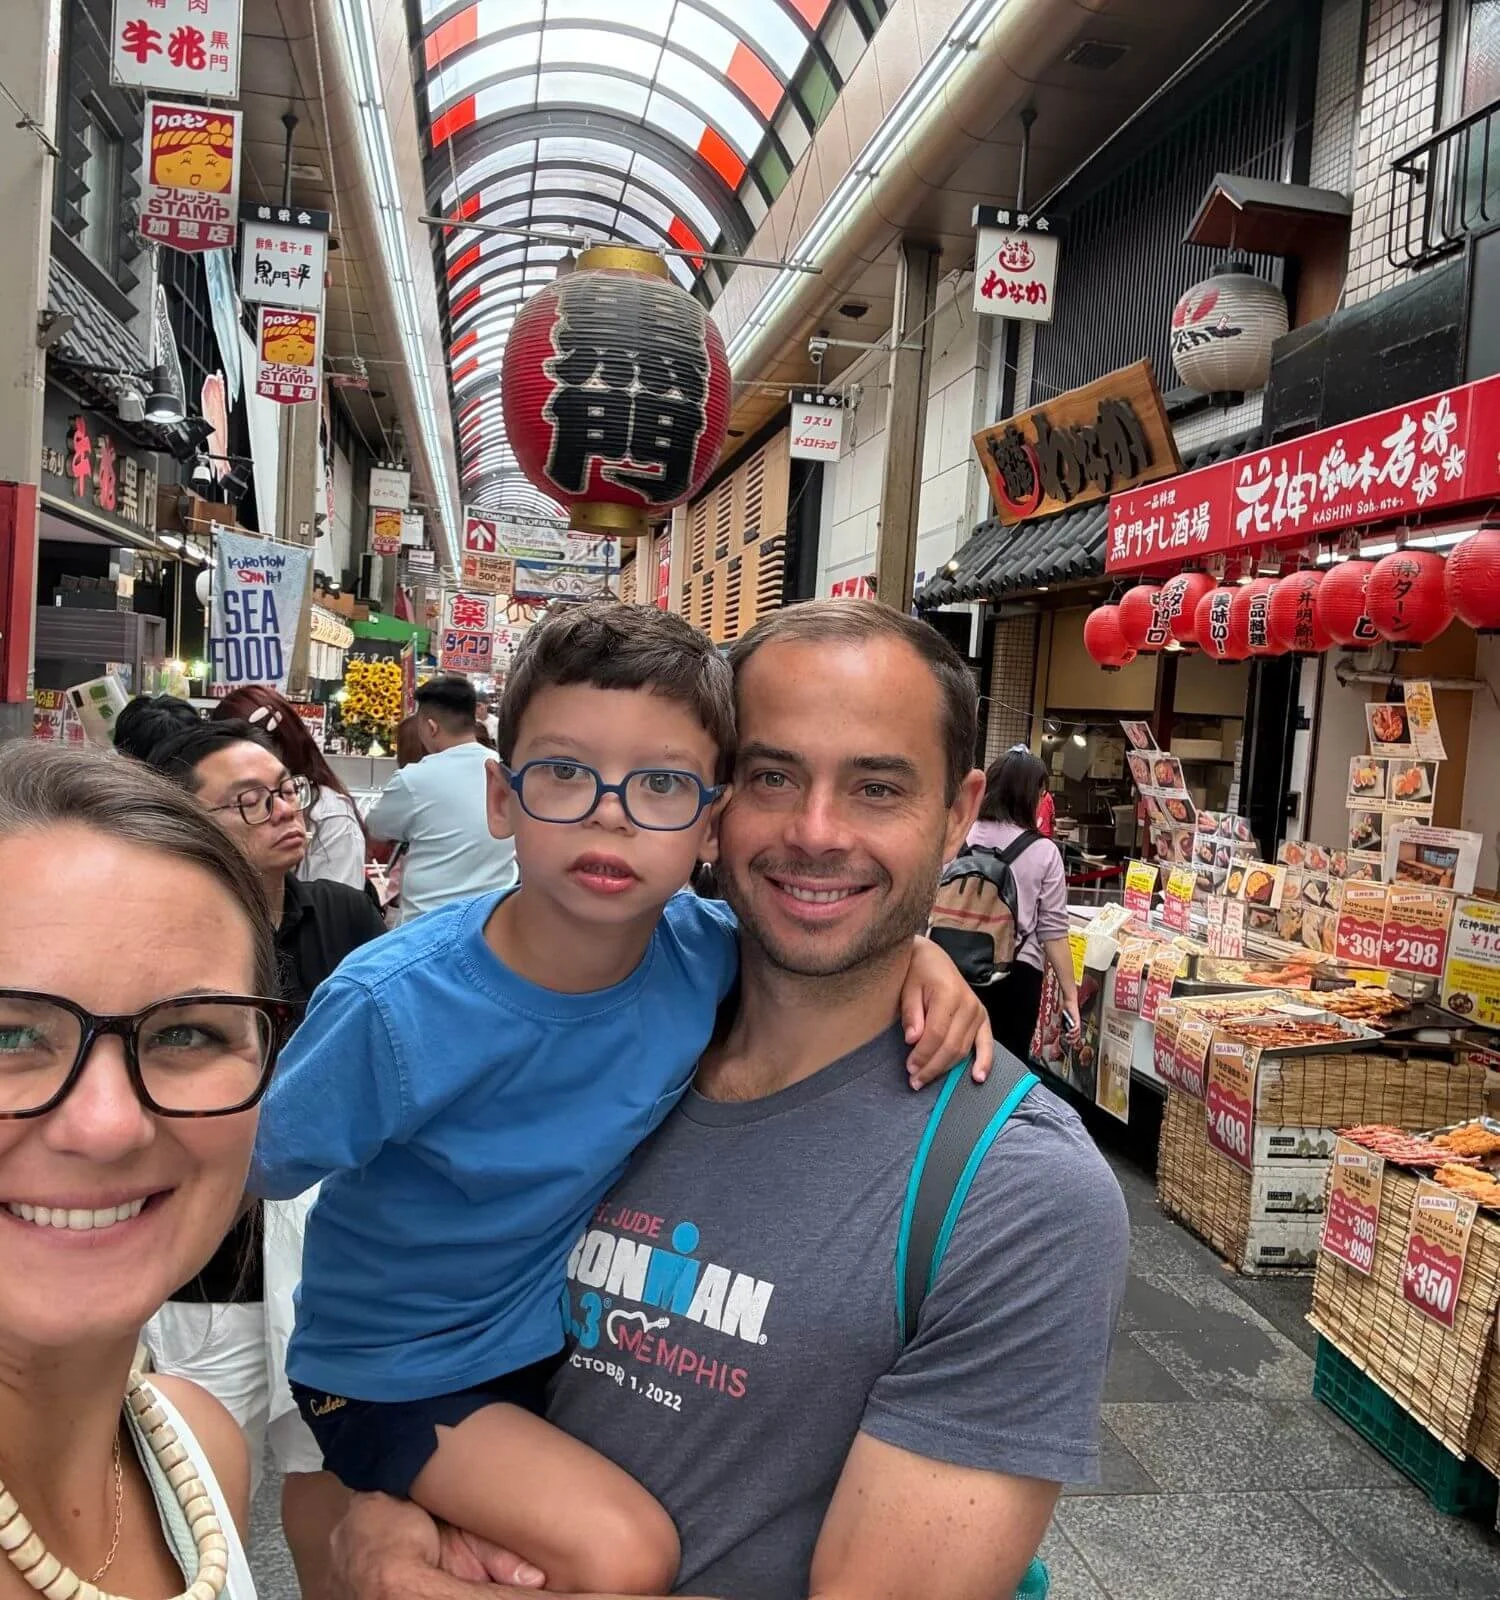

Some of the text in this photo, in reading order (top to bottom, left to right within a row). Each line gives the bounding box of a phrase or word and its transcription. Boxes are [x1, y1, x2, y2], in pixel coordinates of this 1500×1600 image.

[210, 30, 229, 72] 黒門
[154, 113, 207, 130] クロモン
[148, 198, 230, 221] STAMP
[156, 186, 221, 206] フレッシュ
[147, 217, 230, 243] 加盟店
[981, 269, 1048, 305] わなか
[264, 315, 299, 327] クロモン
[260, 382, 314, 399] 加盟店
[261, 370, 313, 385] STAMP
[802, 415, 832, 427] クスリ
[1143, 488, 1177, 510] 一品料理
[1312, 502, 1353, 526] KASHIN
[1110, 500, 1211, 562] 黒門すし酒場
[228, 555, 286, 570] KUROMON
[223, 588, 281, 635] SEA
[449, 593, 490, 629] 薬
[1248, 593, 1269, 648] 一品料理
[209, 635, 285, 682] FOOD
[445, 632, 491, 656] ダイコク
[1383, 937, 1439, 968] ¥298
[1206, 1107, 1247, 1156] ¥498
[612, 1207, 665, 1239] JUDE
[1347, 1214, 1375, 1244] ¥398
[1342, 1238, 1372, 1267] ¥999
[1405, 1260, 1453, 1313] ¥350
[617, 1323, 749, 1398] MEMPHIS
[645, 1383, 682, 1412] 2022
